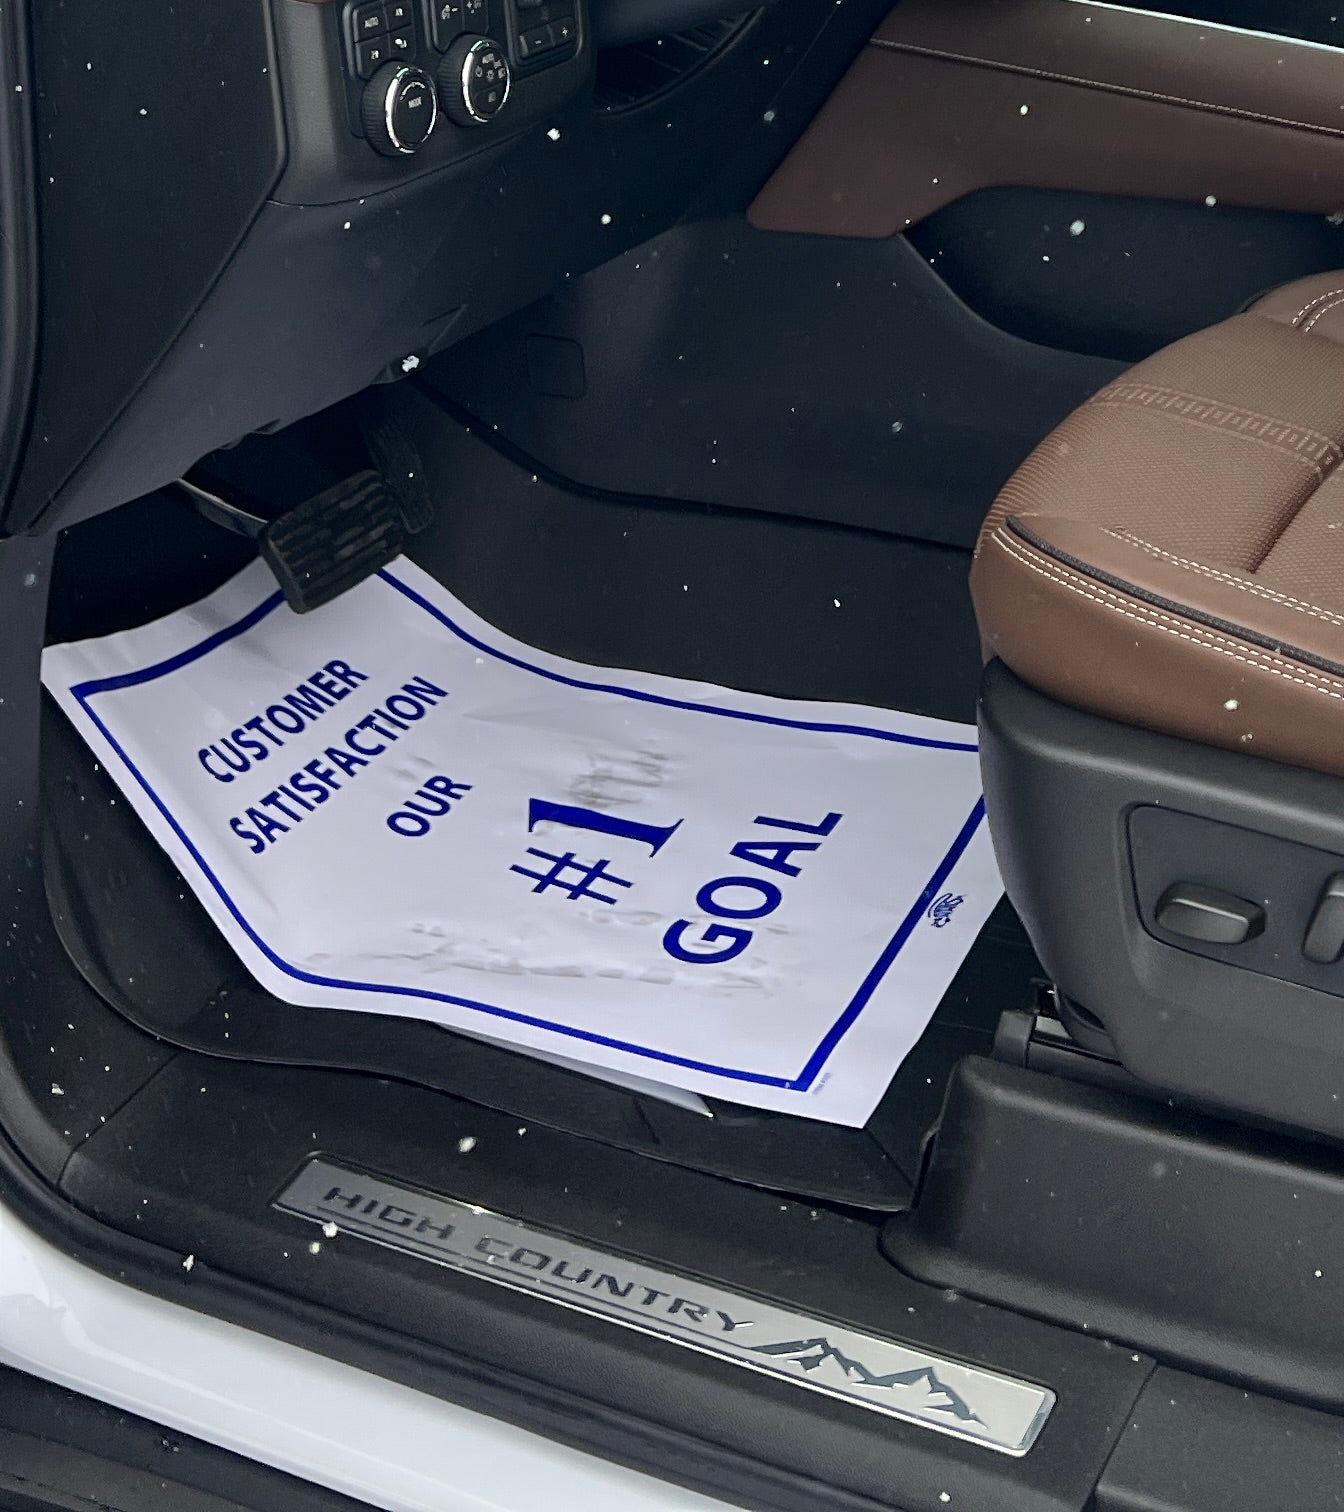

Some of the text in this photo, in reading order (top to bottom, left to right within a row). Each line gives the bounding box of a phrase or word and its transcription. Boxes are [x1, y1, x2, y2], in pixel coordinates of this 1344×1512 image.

[198, 659, 369, 783] CUSTOMER
[229, 675, 449, 854] SATISFACTION
[386, 775, 473, 837] OUR
[510, 797, 683, 905] #1
[662, 812, 843, 965] GOAL
[323, 1187, 755, 1332] HIGH COUNTRY
